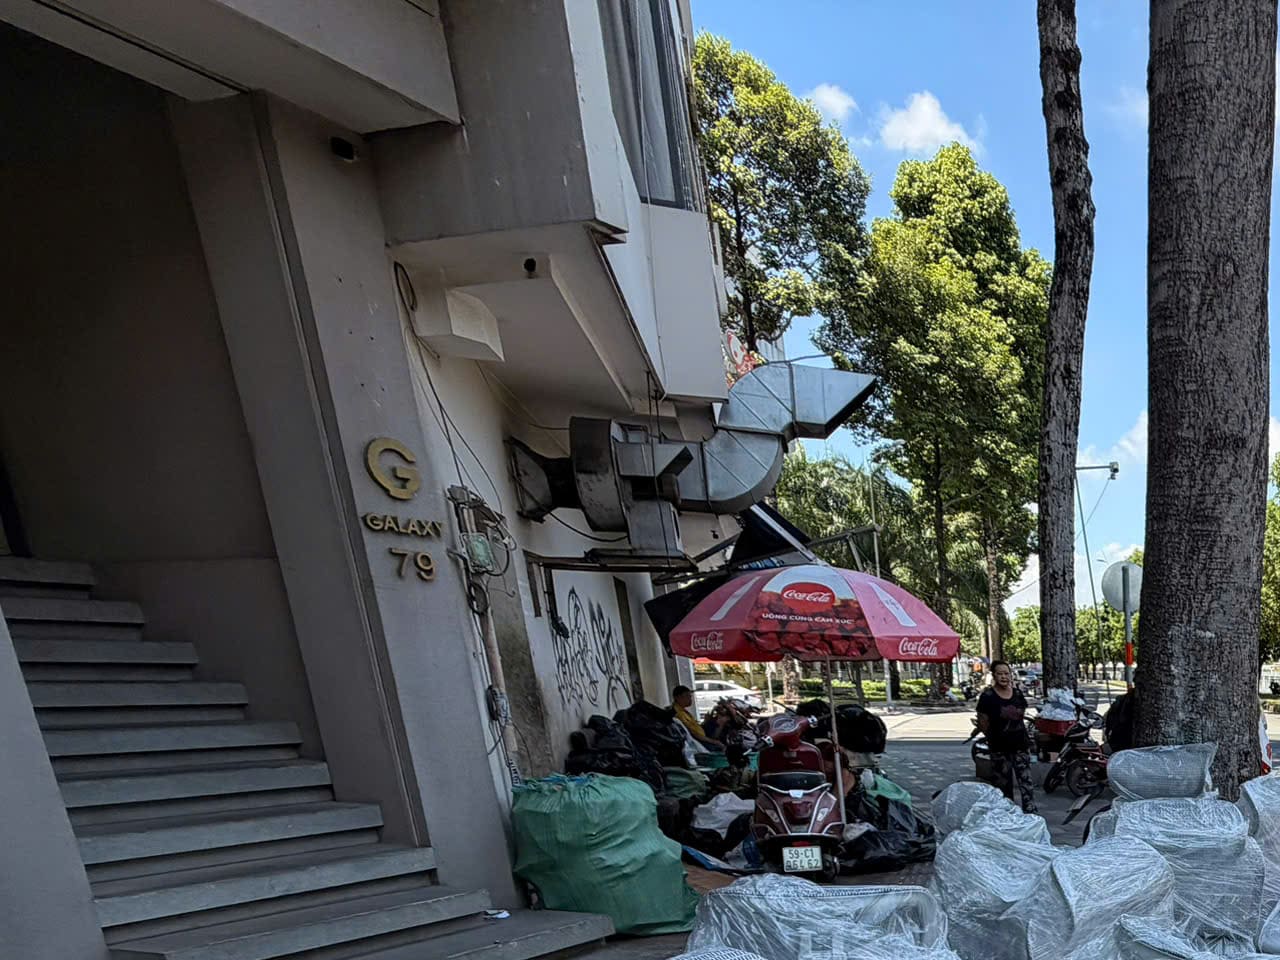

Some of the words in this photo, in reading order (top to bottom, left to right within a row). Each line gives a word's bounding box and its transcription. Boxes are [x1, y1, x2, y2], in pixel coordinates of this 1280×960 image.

[363, 511, 444, 537] GALAXY
[389, 547, 437, 581] 79
[783, 589, 833, 603] Coca-Cola
[899, 637, 940, 656] Coca-Cola
